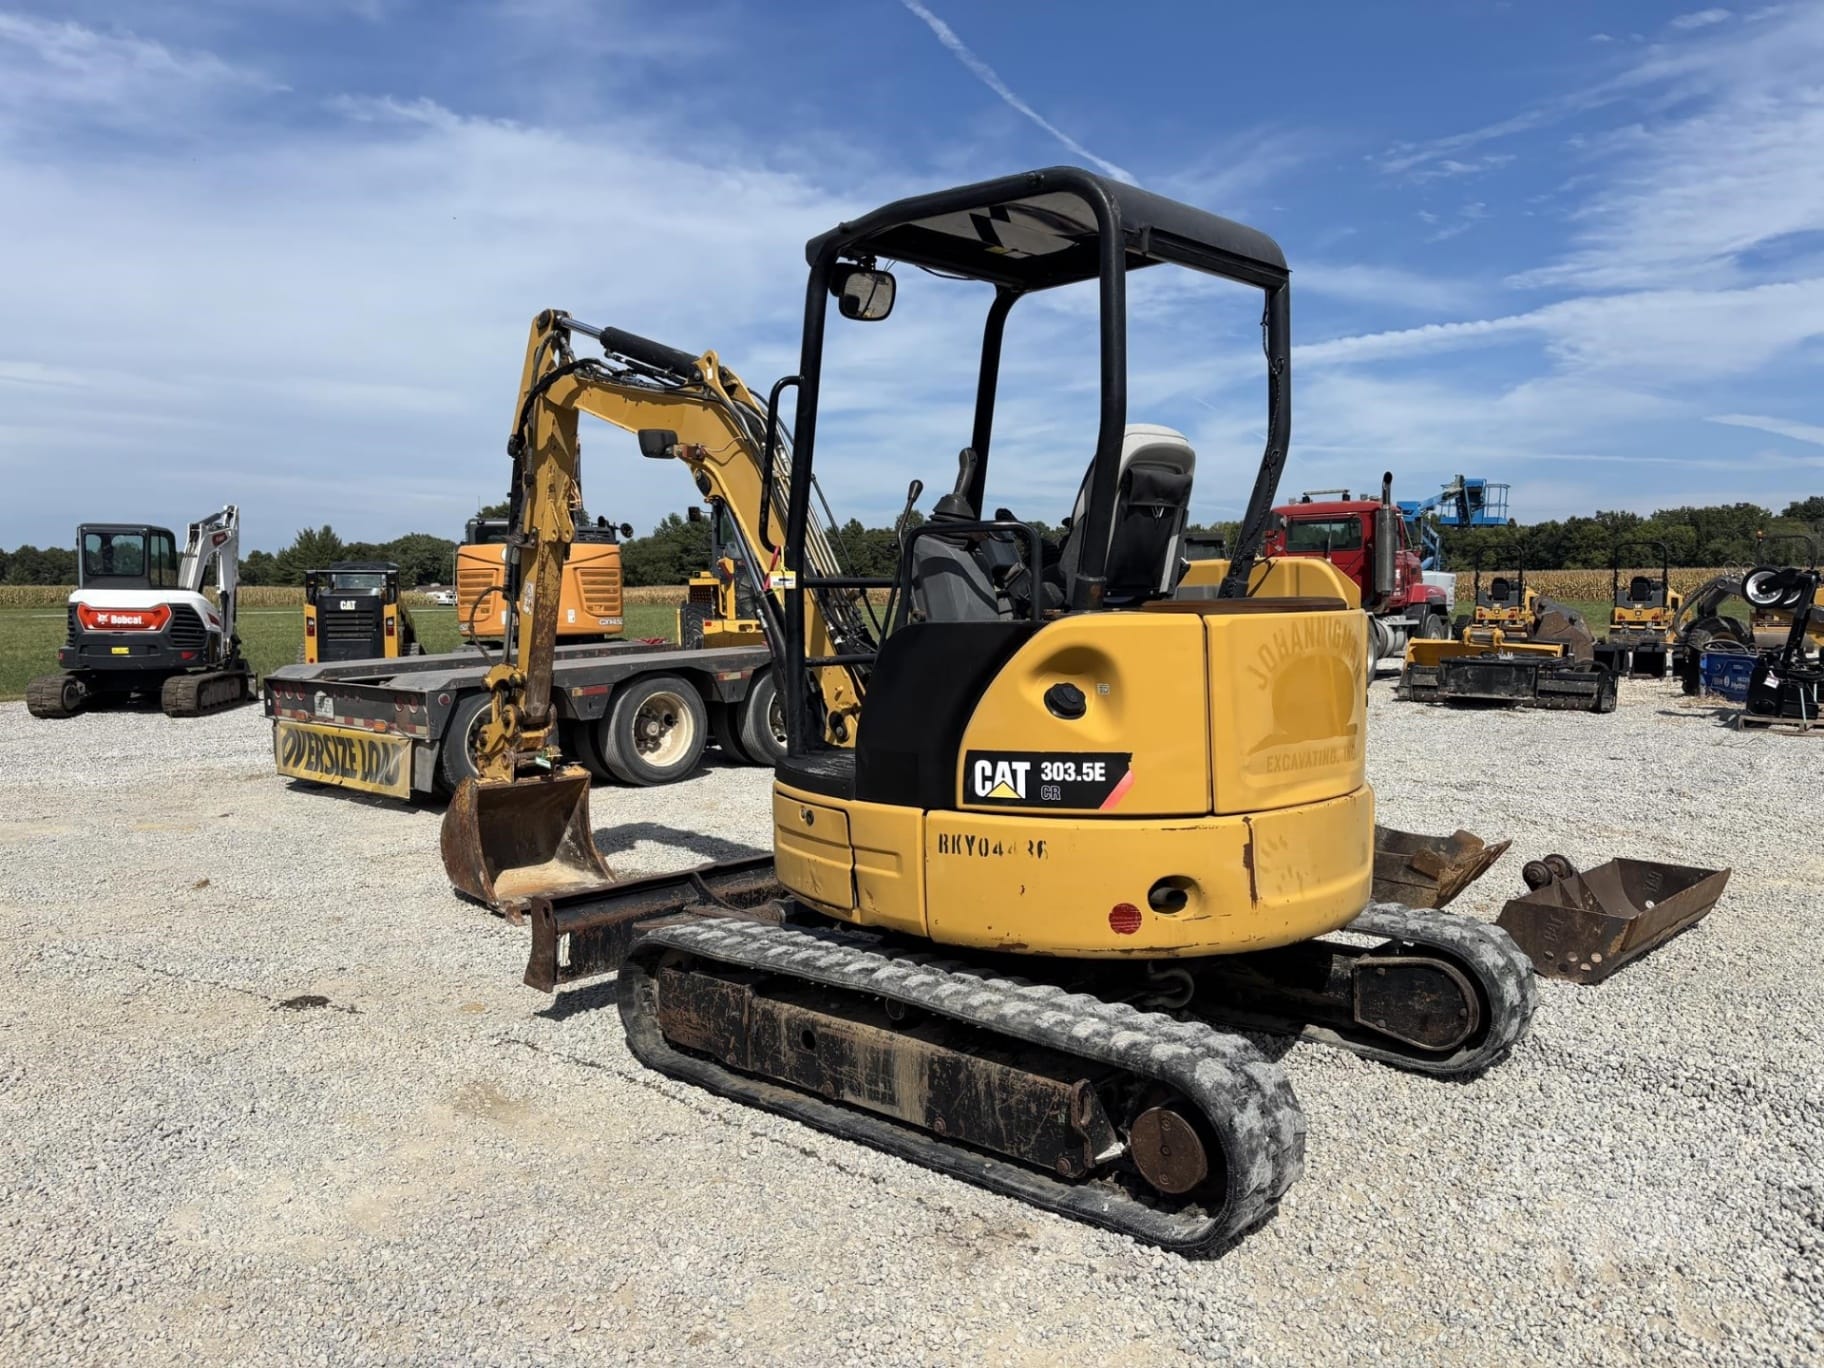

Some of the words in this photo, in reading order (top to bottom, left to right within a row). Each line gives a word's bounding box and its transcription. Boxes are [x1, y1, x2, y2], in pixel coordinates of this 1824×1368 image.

[340, 600, 357, 610] CAT
[110, 615, 143, 625] Bobcat
[282, 728, 357, 779] OVERSIZE
[358, 739, 401, 786] LOAD
[974, 759, 1031, 799] CAT
[1041, 762, 1106, 782] 303.5E
[1041, 785, 1062, 800] CR
